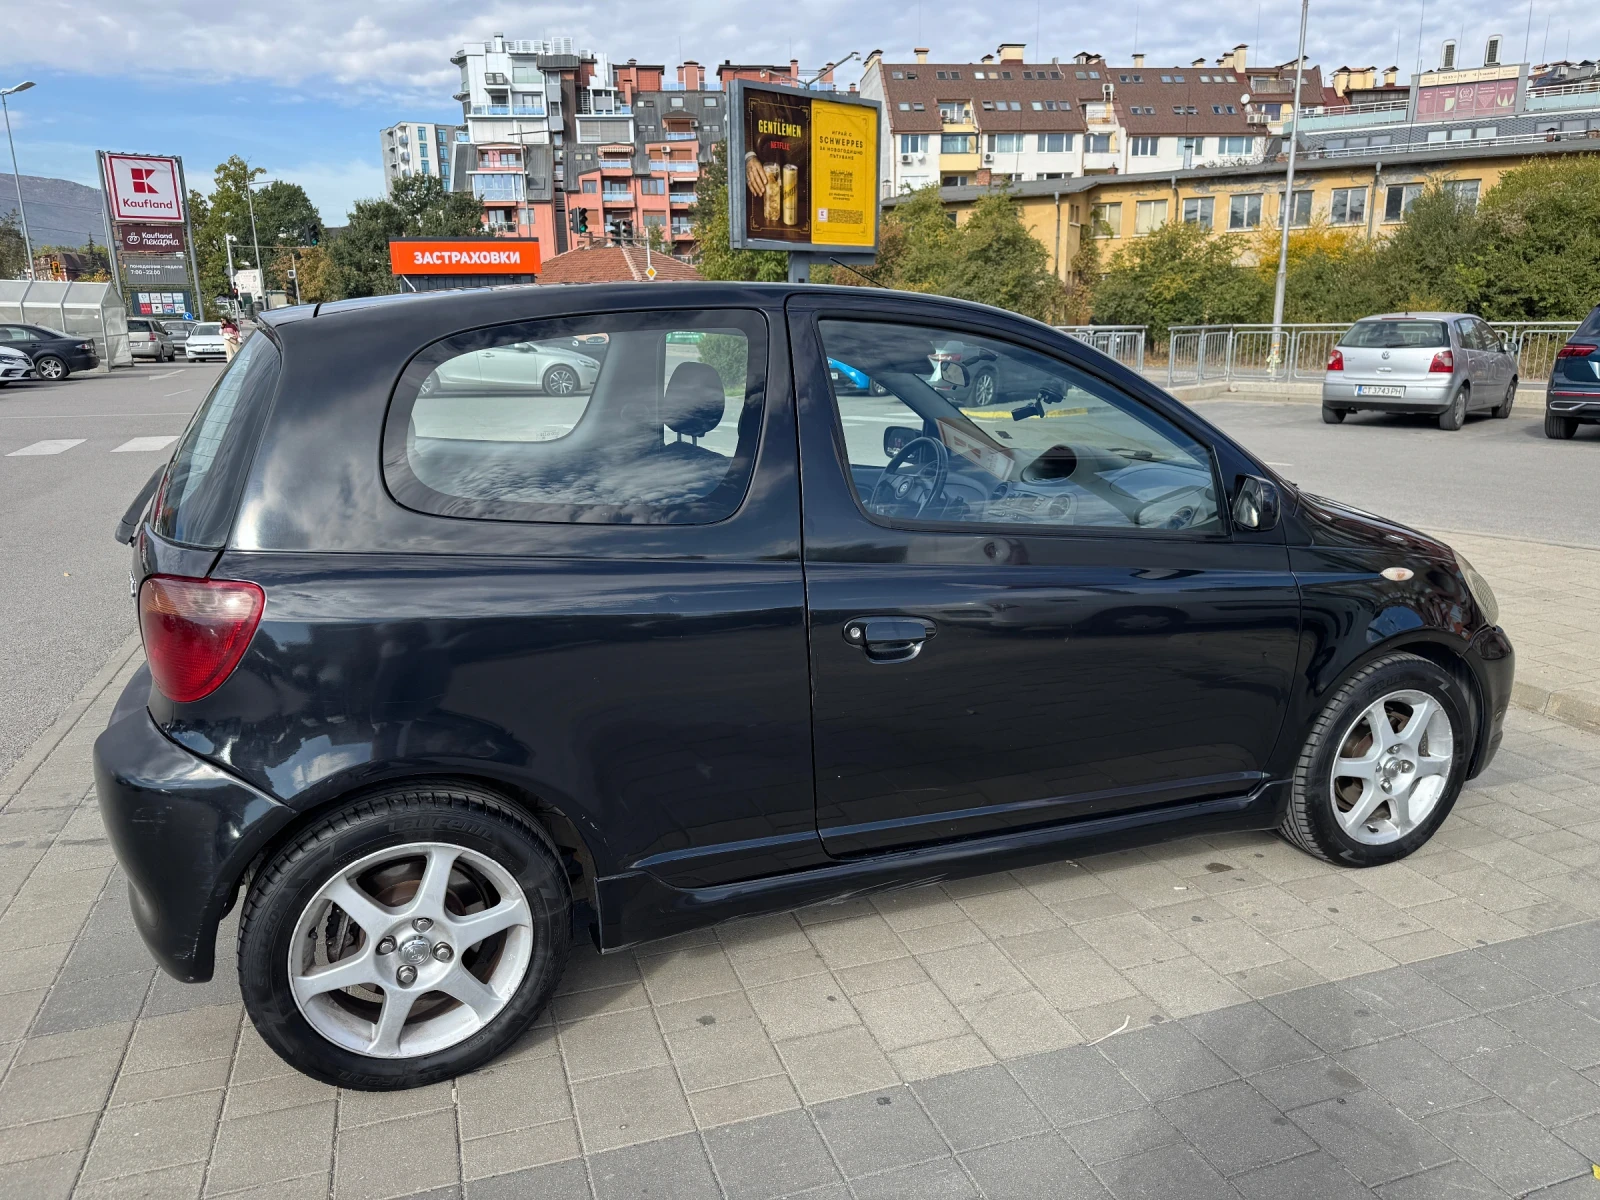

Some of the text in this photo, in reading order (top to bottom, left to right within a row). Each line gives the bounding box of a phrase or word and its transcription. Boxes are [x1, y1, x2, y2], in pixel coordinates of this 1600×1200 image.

[758, 119, 802, 138] GENTLEMEN
[819, 136, 864, 149] SCHWEPPES
[122, 198, 173, 209] Kaufland
[141, 231, 173, 239] Kaufland
[142, 238, 180, 247] пекарна
[413, 251, 521, 265] ЗАСТРАХОВКИ
[1371, 387, 1390, 395] 3743
